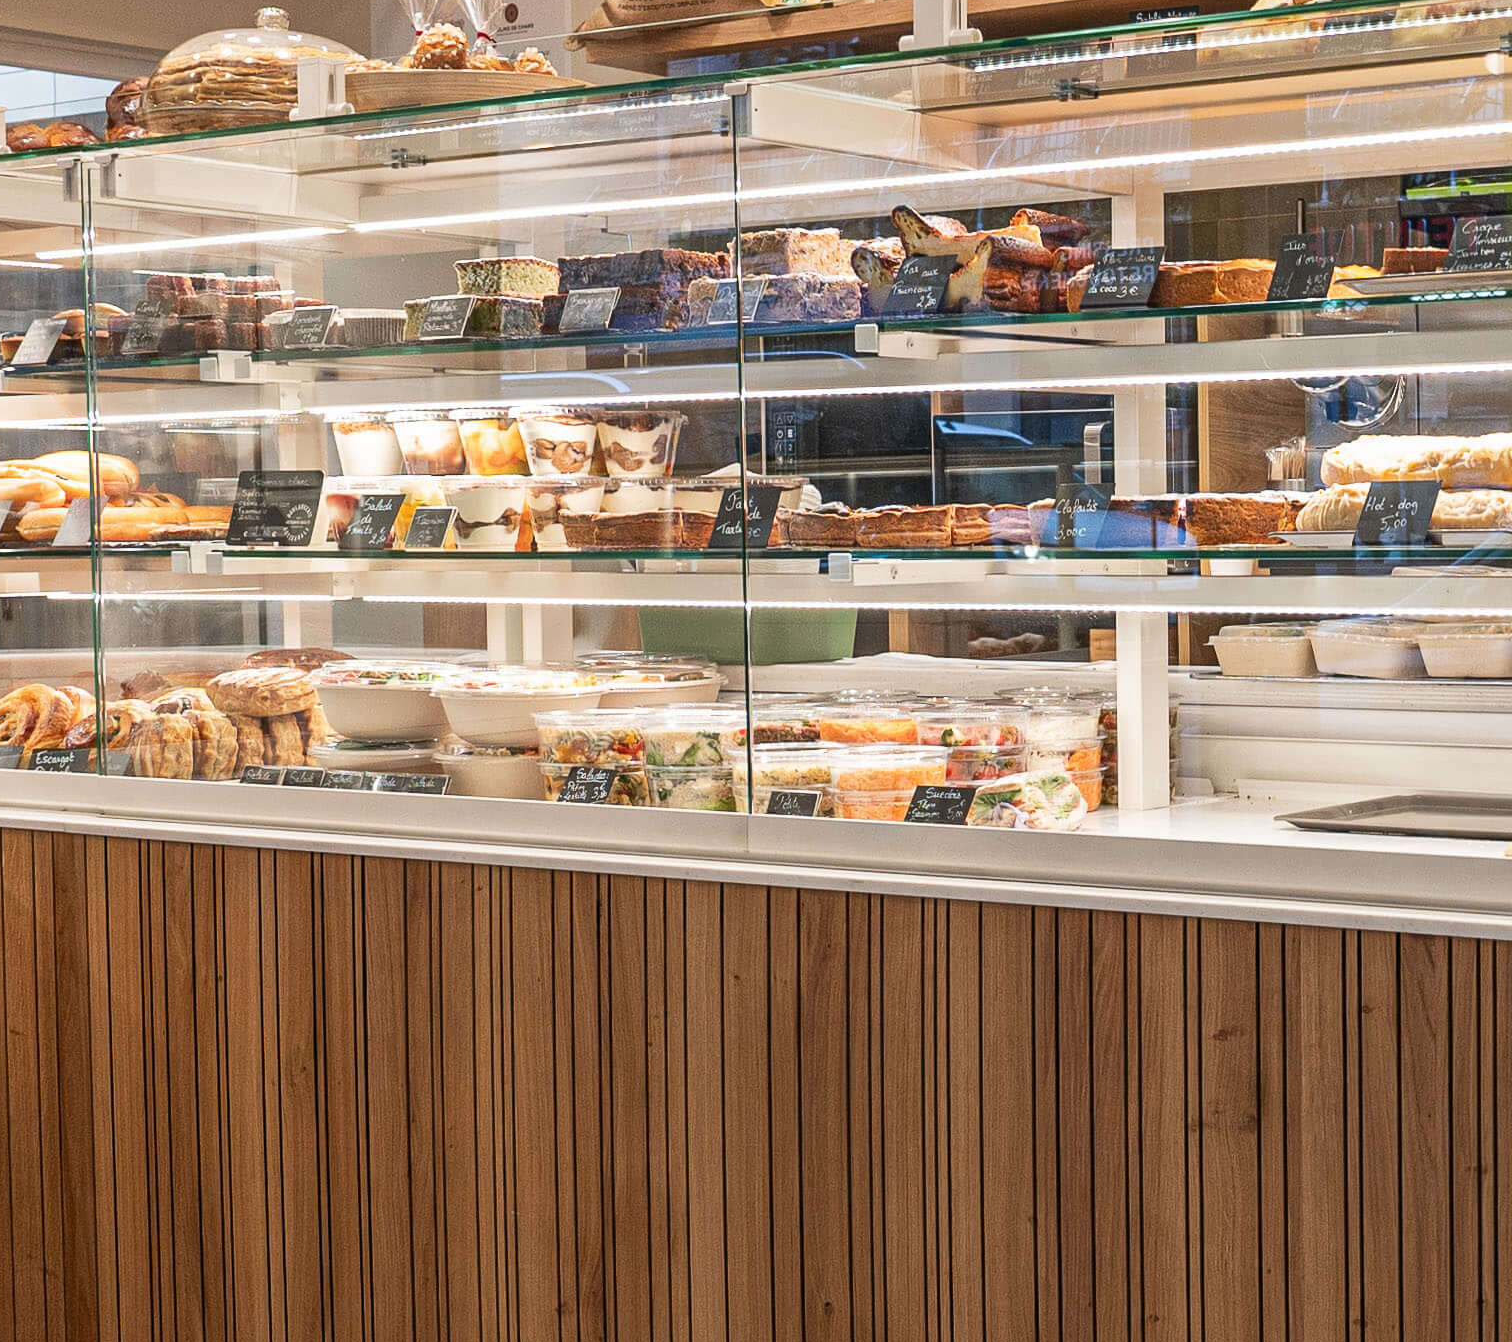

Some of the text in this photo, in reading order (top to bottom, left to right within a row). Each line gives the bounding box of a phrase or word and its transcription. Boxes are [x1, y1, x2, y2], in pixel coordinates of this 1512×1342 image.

[1462, 219, 1504, 235] Croque
[921, 269, 939, 277] aux
[364, 497, 393, 510] Salade
[1056, 501, 1098, 518] Clafoutis
[360, 514, 373, 524] de
[36, 752, 75, 766] Escargot
